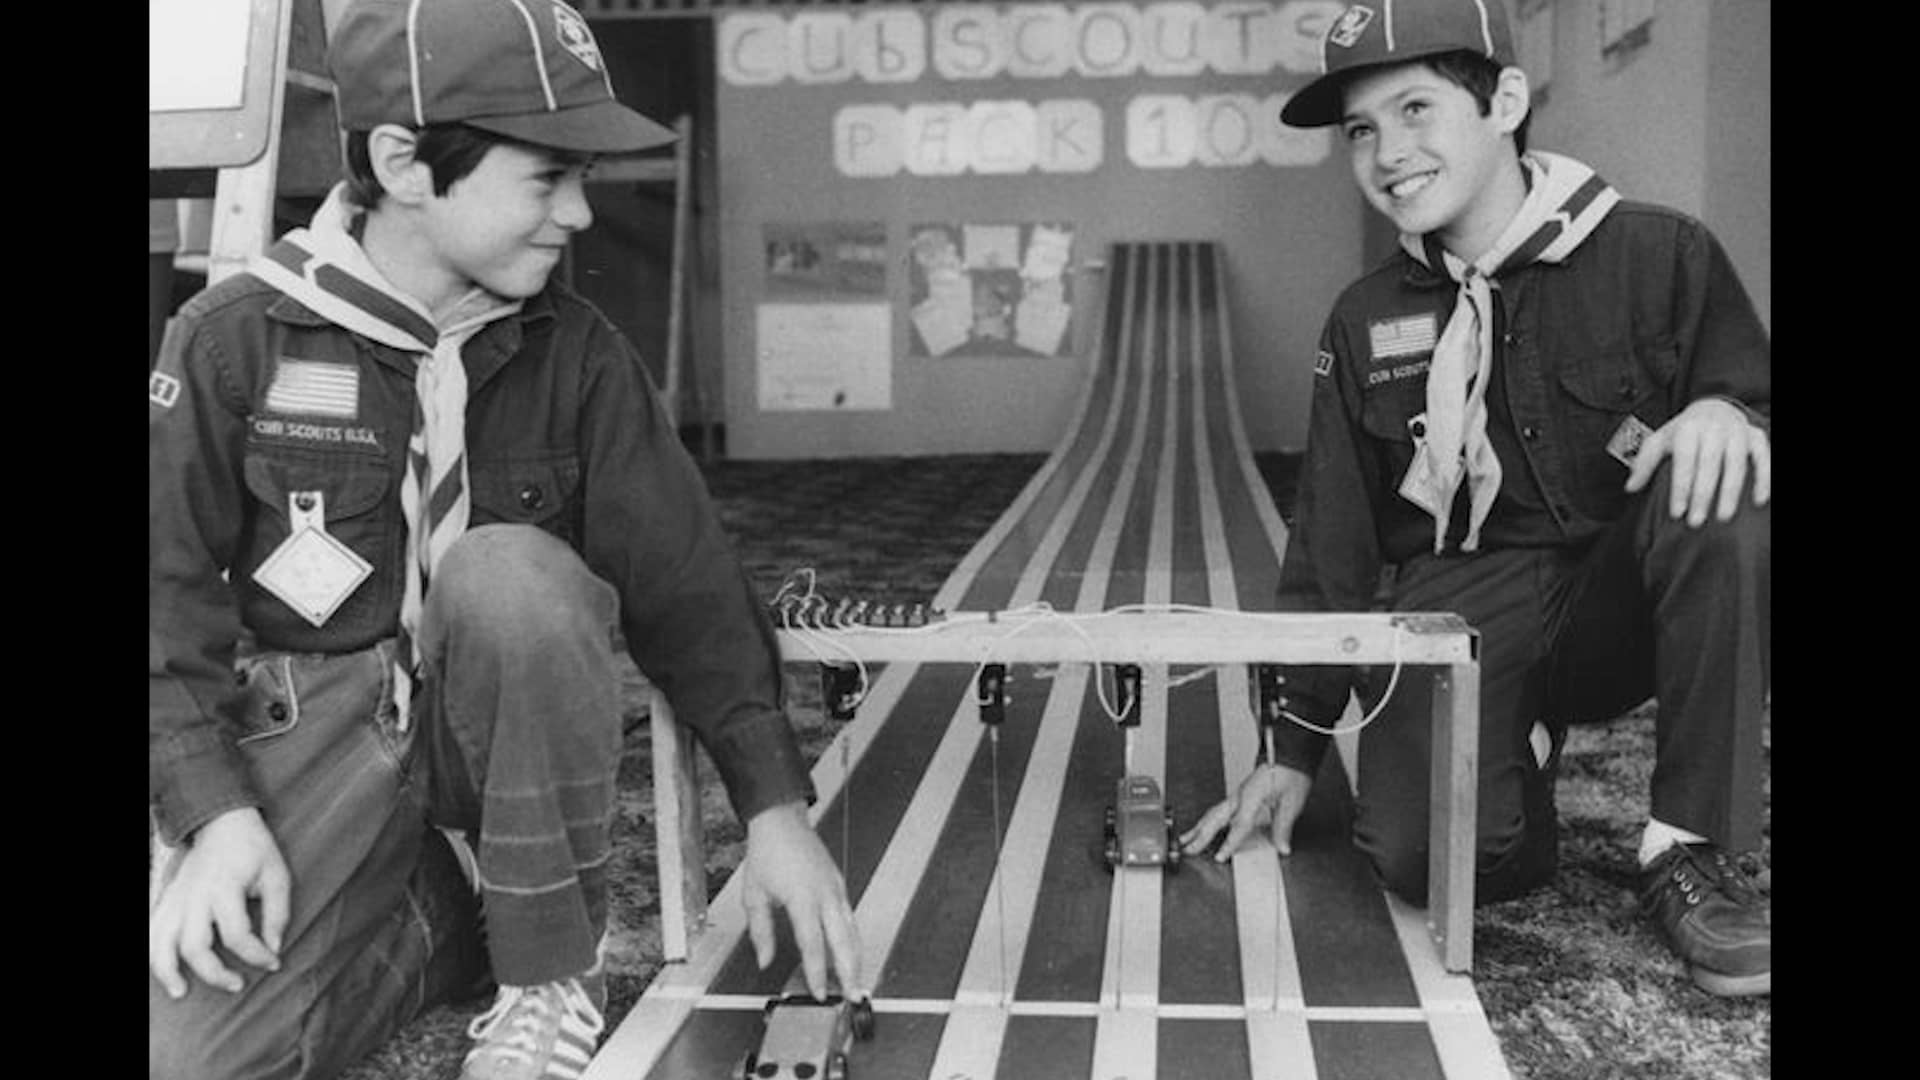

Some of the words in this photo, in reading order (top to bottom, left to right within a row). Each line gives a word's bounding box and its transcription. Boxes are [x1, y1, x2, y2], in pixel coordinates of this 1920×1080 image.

[952, 9, 1324, 72] SCOUTS
[848, 112, 1085, 164] PACK
[287, 423, 342, 442] SCOUTS
